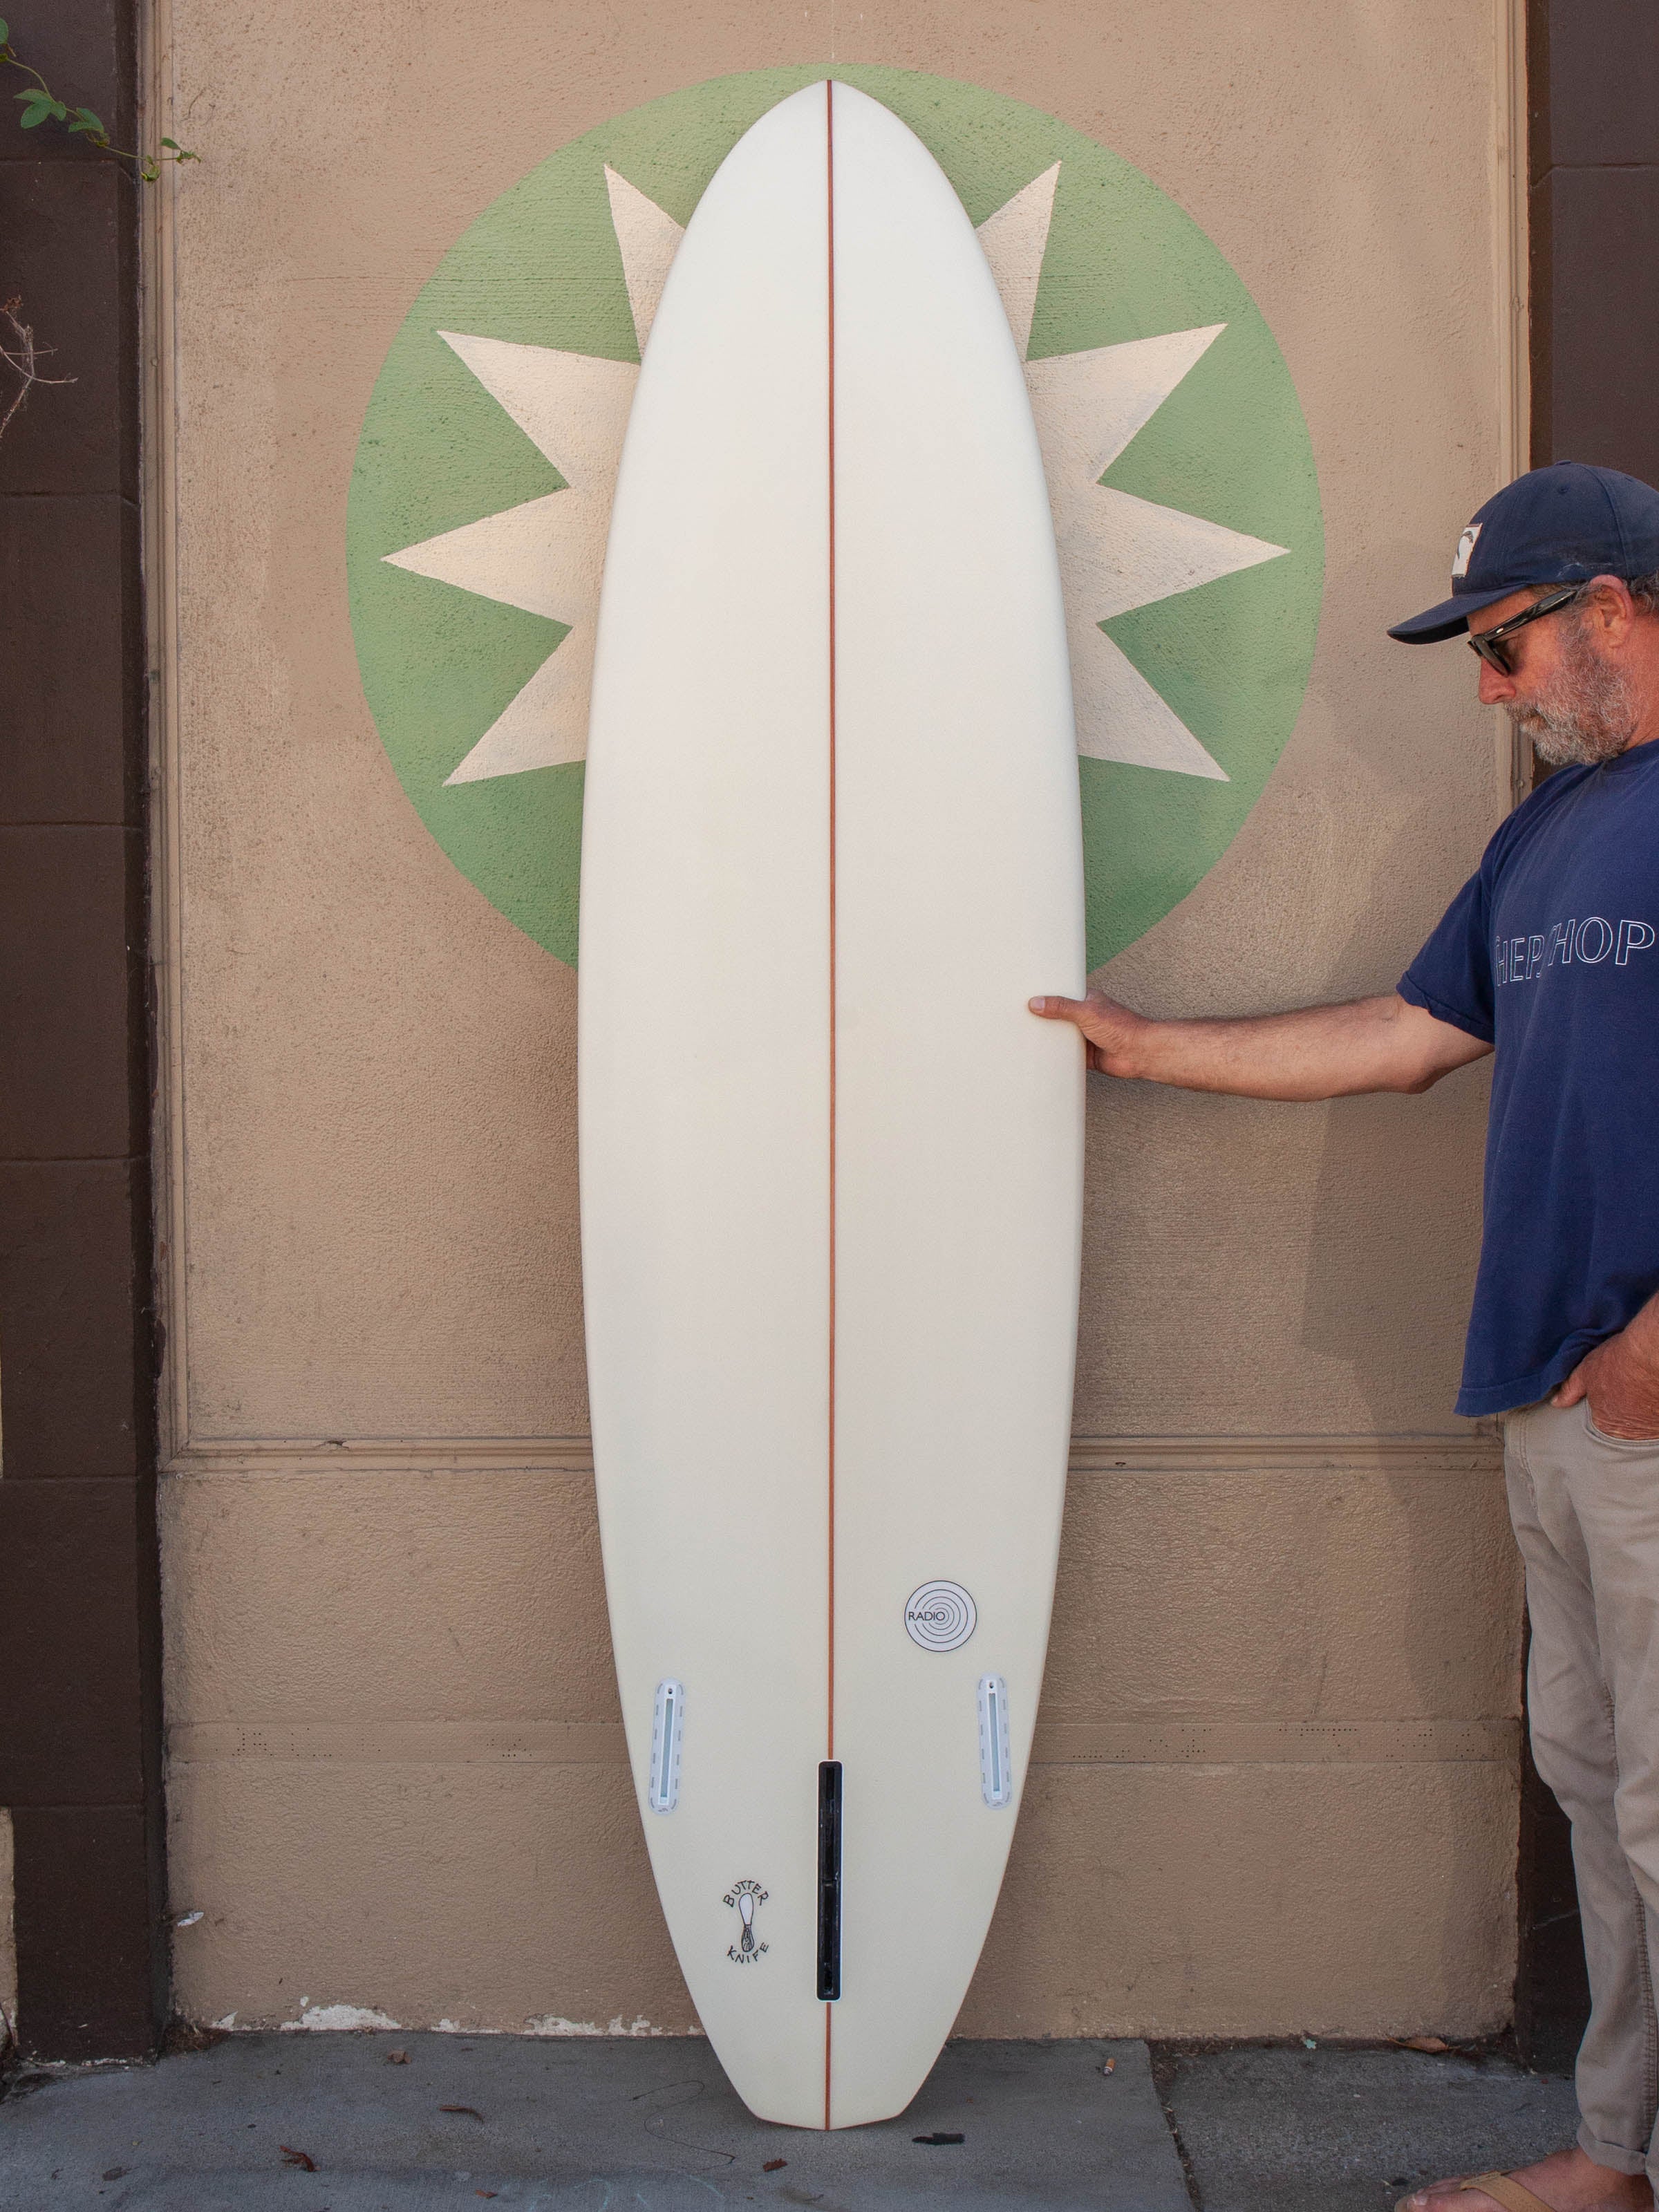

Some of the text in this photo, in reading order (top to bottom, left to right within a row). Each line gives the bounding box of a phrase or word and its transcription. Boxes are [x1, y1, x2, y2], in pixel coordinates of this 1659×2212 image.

[908, 1611, 946, 1621] RADIO
[722, 1880, 769, 1908] BUTTER
[727, 1942, 769, 1964] KNIFE
